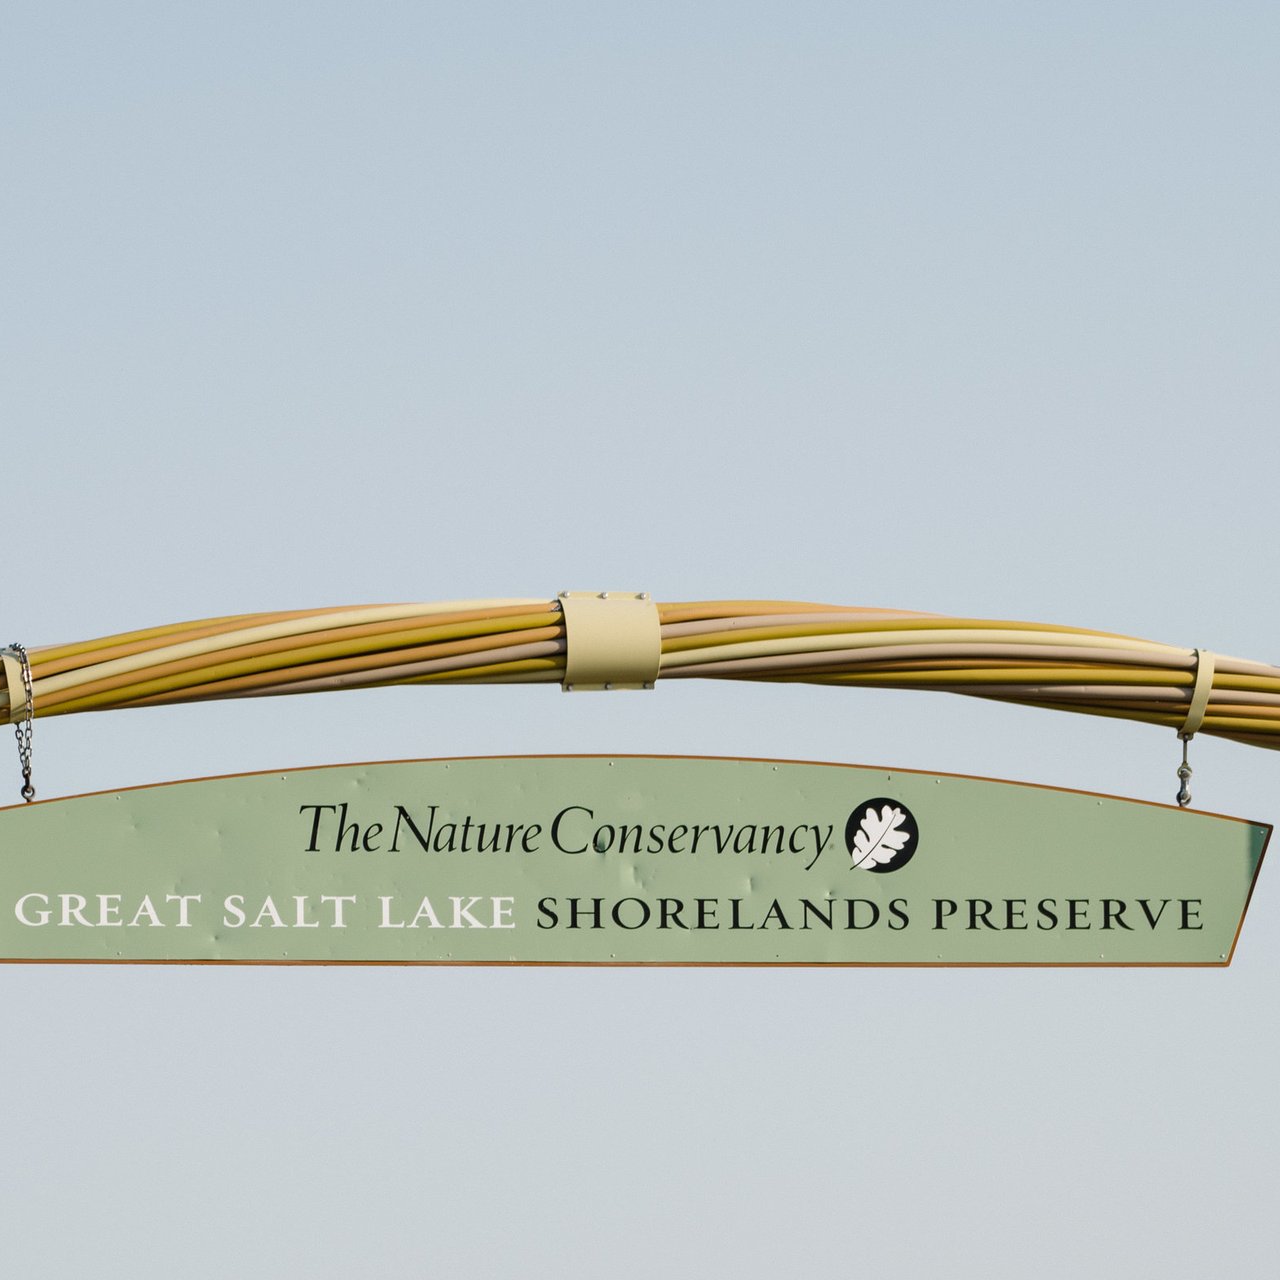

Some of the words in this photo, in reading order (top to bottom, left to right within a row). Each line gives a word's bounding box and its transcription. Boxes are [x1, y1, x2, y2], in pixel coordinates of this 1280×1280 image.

[298, 803, 383, 853] The
[388, 805, 541, 853] Nature
[549, 805, 834, 871] Conservancy
[14, 892, 202, 928] GREAT
[222, 893, 357, 928] SALT
[376, 894, 516, 929] LAKE
[536, 896, 910, 931] SHORELANDS
[931, 898, 1205, 931] PRESERVE
